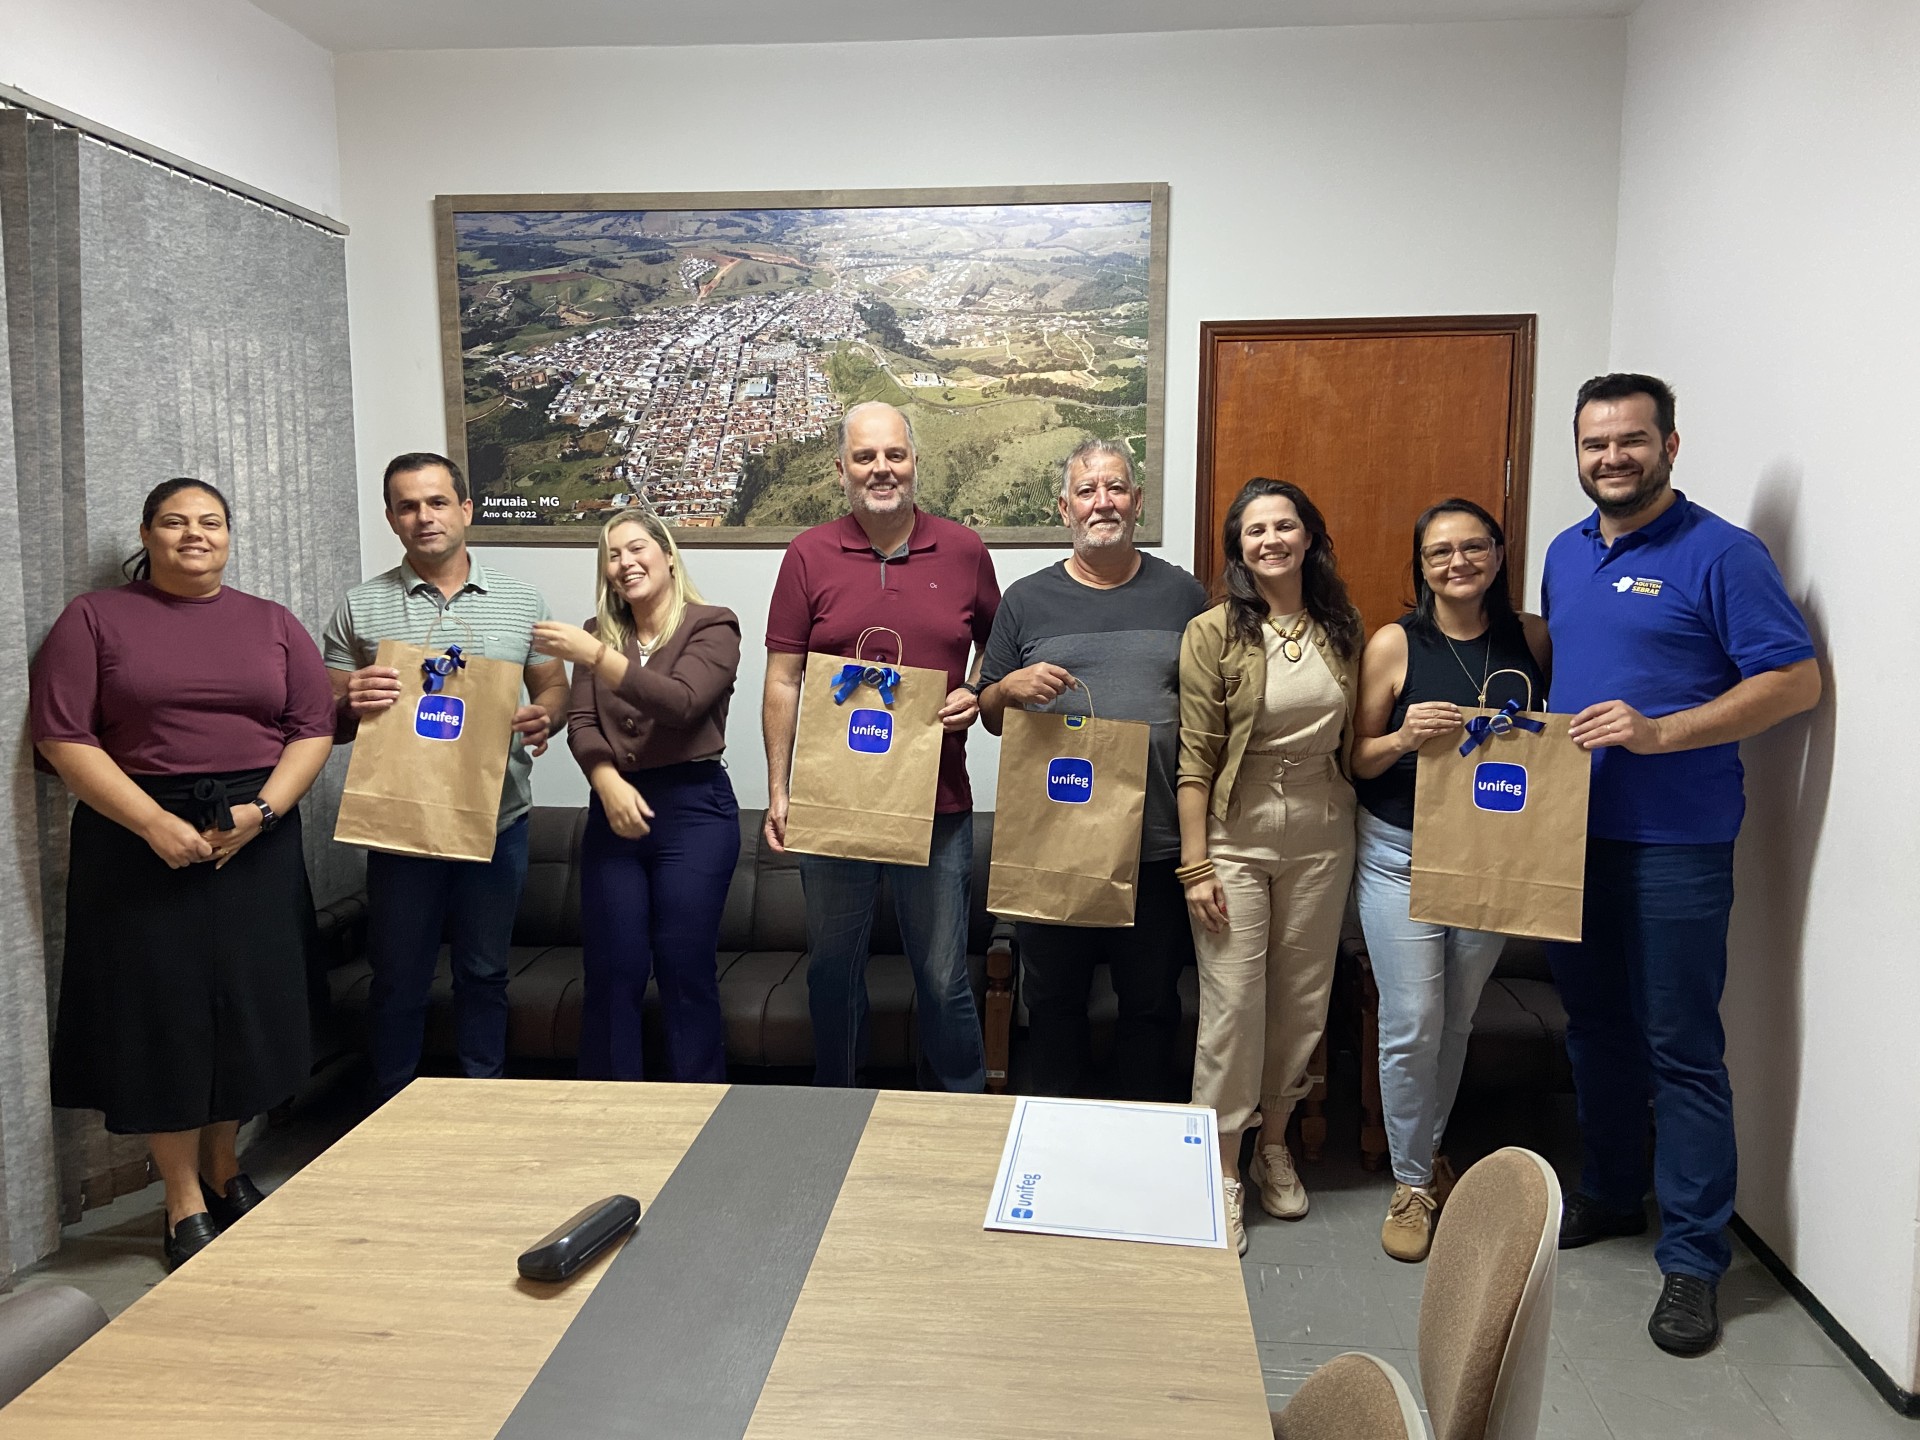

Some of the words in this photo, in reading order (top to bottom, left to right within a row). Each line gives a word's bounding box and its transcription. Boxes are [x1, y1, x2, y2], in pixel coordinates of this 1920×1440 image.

[482, 496, 528, 507] Juruaia
[540, 496, 560, 507] MG
[514, 511, 537, 519] 2022
[1631, 586, 1660, 595] SEBRAE
[419, 711, 460, 726] unifeg
[852, 724, 889, 740] unifeg
[1051, 773, 1089, 789] unifeg
[1478, 780, 1522, 796] unifeg
[1016, 1173, 1042, 1207] unifeg
